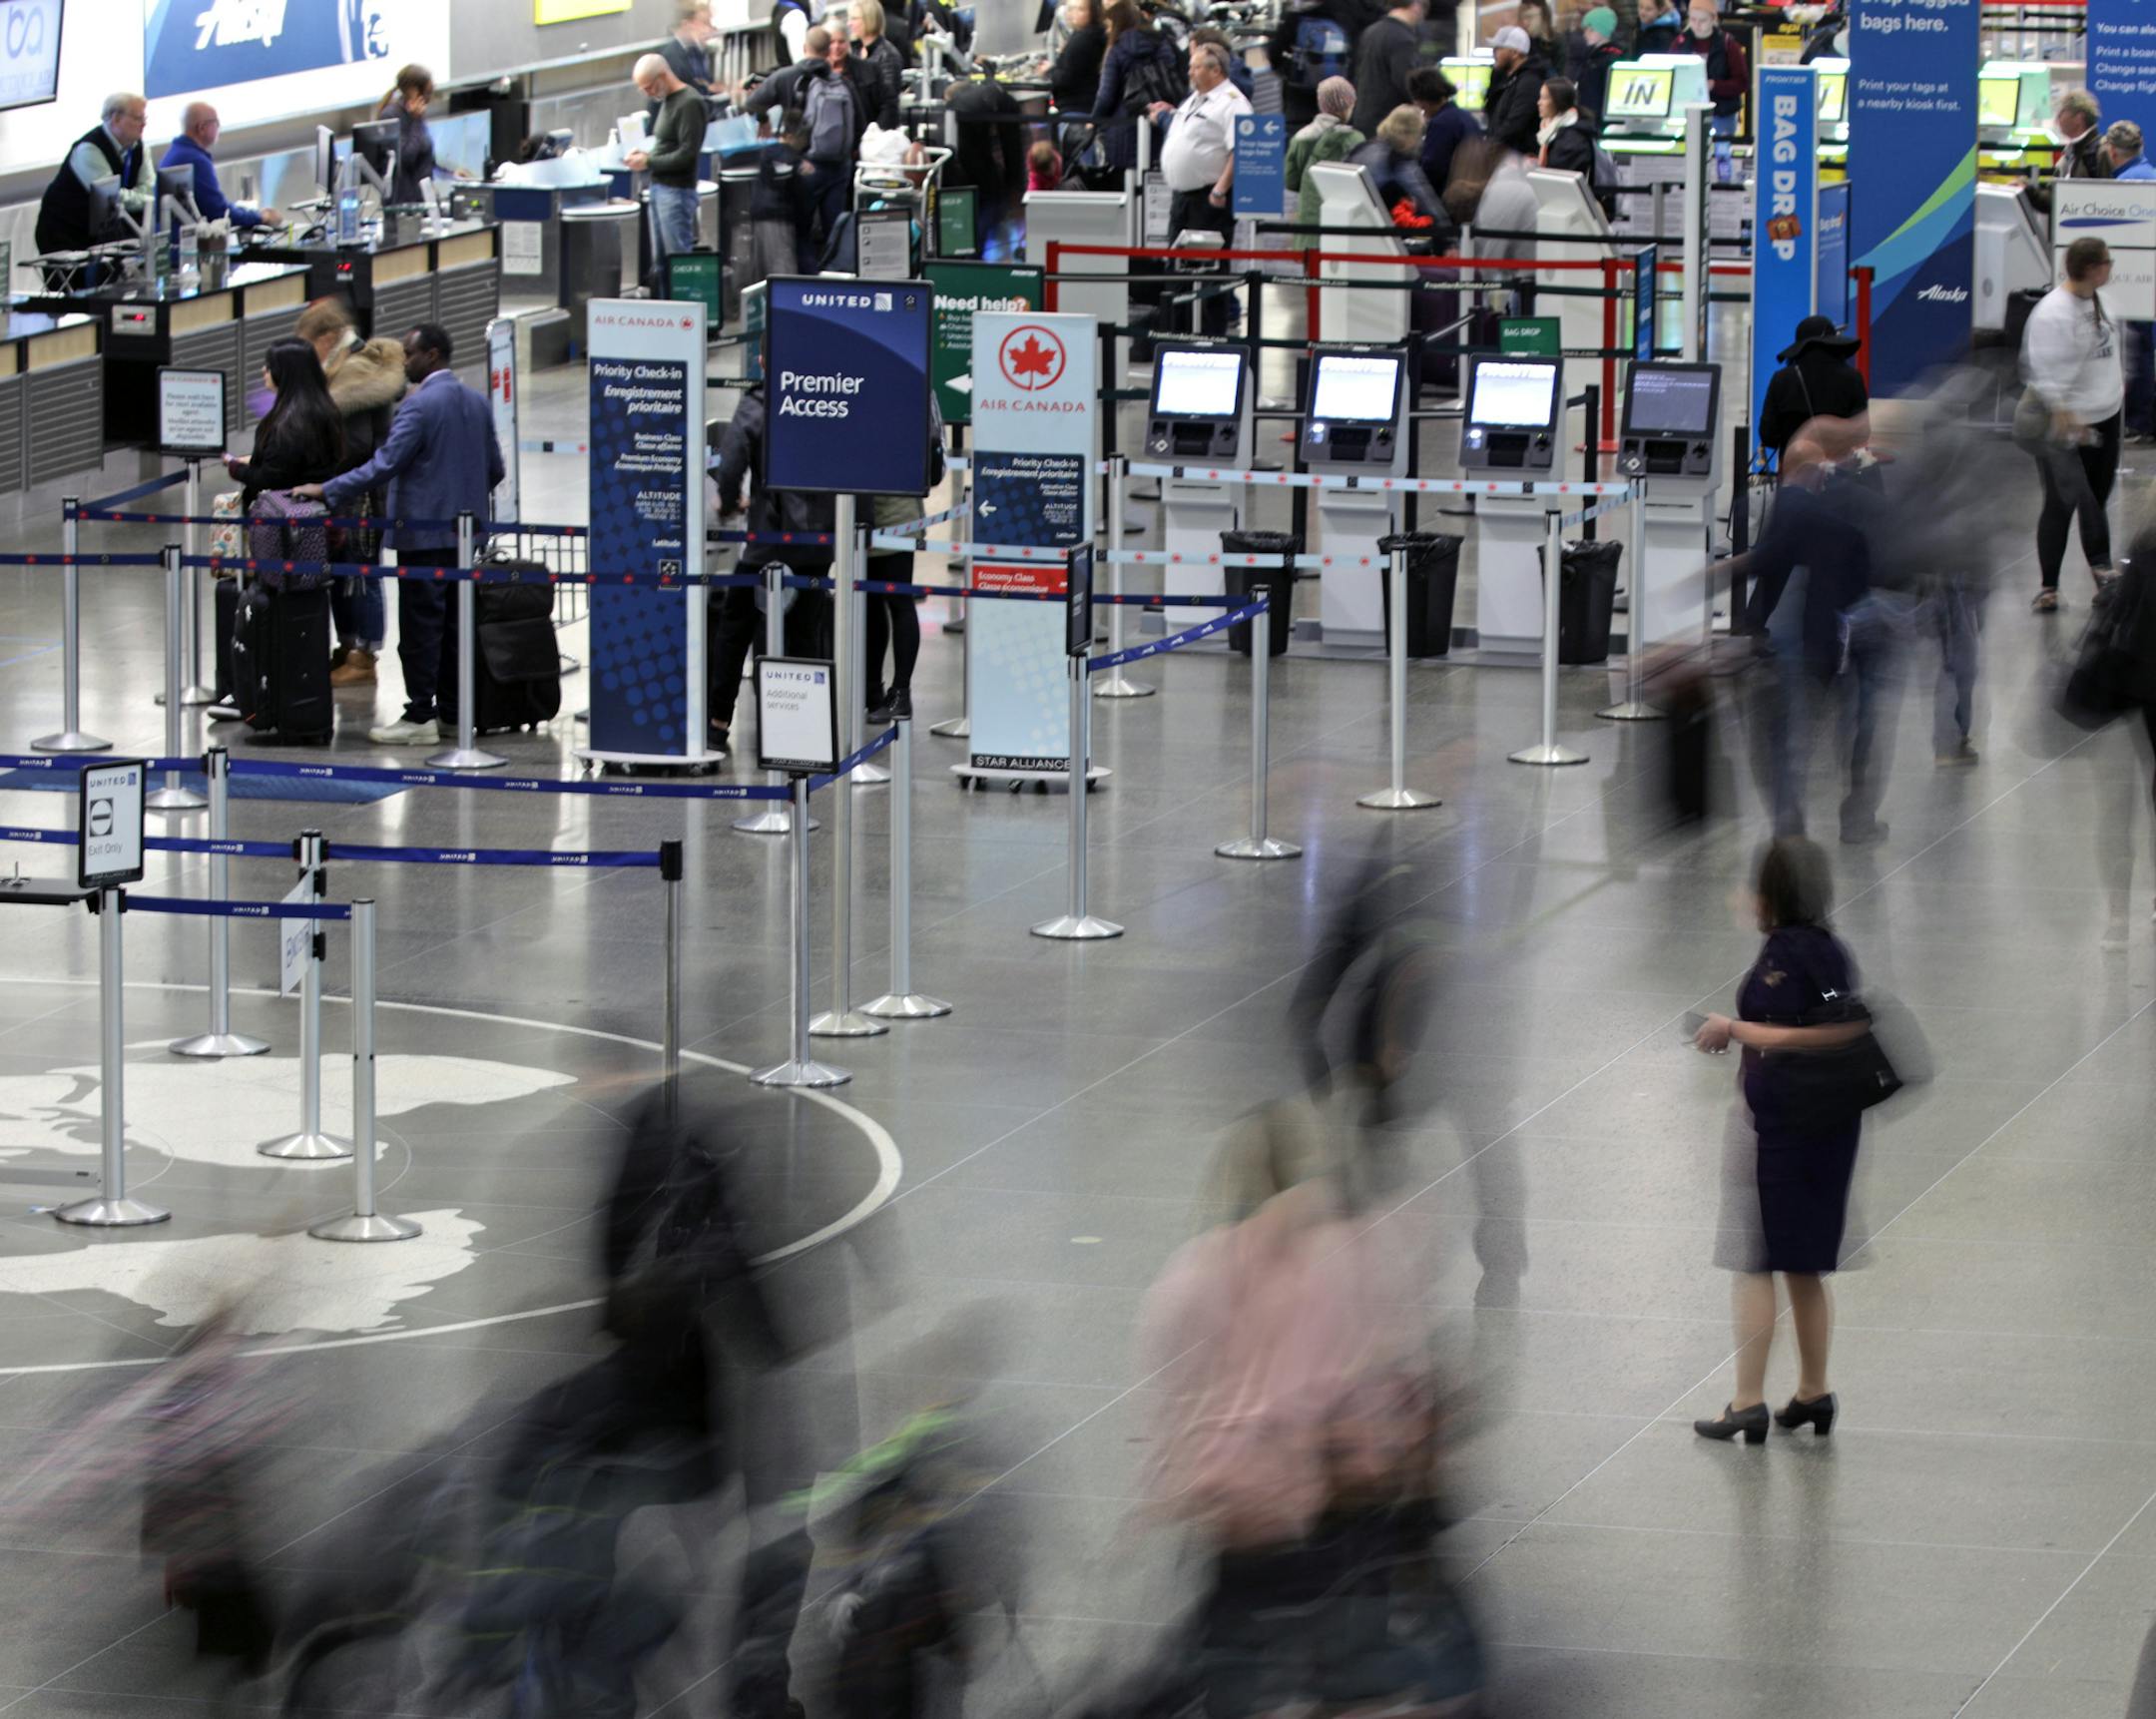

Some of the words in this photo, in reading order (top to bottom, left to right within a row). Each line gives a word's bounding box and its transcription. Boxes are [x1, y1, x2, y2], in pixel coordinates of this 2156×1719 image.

[1860, 12, 1901, 35] bags
[1904, 13, 1949, 33] here.
[2096, 22, 2117, 34] You
[2118, 25, 2138, 34] can
[2096, 46, 2121, 57] Print
[2095, 62, 2136, 76] Change
[1765, 75, 1808, 84] FRONTIER
[2095, 79, 2136, 94] Change
[1623, 82, 1657, 105] IN
[1858, 79, 1885, 92] Print
[1886, 82, 1910, 94] your
[1911, 81, 1935, 95] tags
[1937, 82, 1948, 92] at
[1866, 98, 1903, 111] nearby
[1904, 98, 1933, 110] kiosk
[1934, 98, 1961, 111] first.
[1773, 95, 1798, 164] BAG
[2060, 203, 2081, 216] Air
[2083, 202, 2126, 217] Choice
[2128, 204, 2156, 217] One
[1917, 284, 1968, 302] Alaska
[802, 293, 871, 308] UNITED
[934, 294, 978, 310] Need
[981, 295, 1027, 312] help?
[595, 315, 615, 325] AIR
[618, 316, 675, 328] CANADA
[1503, 327, 1518, 337] BAG
[1519, 327, 1542, 336] DROP
[594, 363, 633, 381] Priority
[634, 365, 683, 379] Check-in
[780, 371, 864, 394] Premier
[604, 384, 683, 402] Enregistrement
[627, 399, 683, 415] prioritaire
[779, 395, 848, 418] Access
[980, 398, 1007, 410] AIR
[1012, 399, 1086, 412] CANADA
[1012, 458, 1043, 469] Priority
[1043, 459, 1079, 468] Check-in
[981, 466, 1038, 479] Enregistrement
[1038, 470, 1079, 480] prioritaire
[637, 490, 682, 500] ALTITUDE
[977, 571, 1012, 584] Economy
[1013, 572, 1035, 583] Class
[977, 581, 1001, 591] Classe
[766, 670, 811, 682] UNITED
[766, 689, 808, 700] Additional
[767, 701, 800, 712] services
[975, 756, 1007, 767] STAR
[1008, 758, 1070, 771] ALLIANCE
[89, 775, 127, 788] UNITED
[88, 846, 103, 857] Exit
[104, 843, 123, 855] Only
